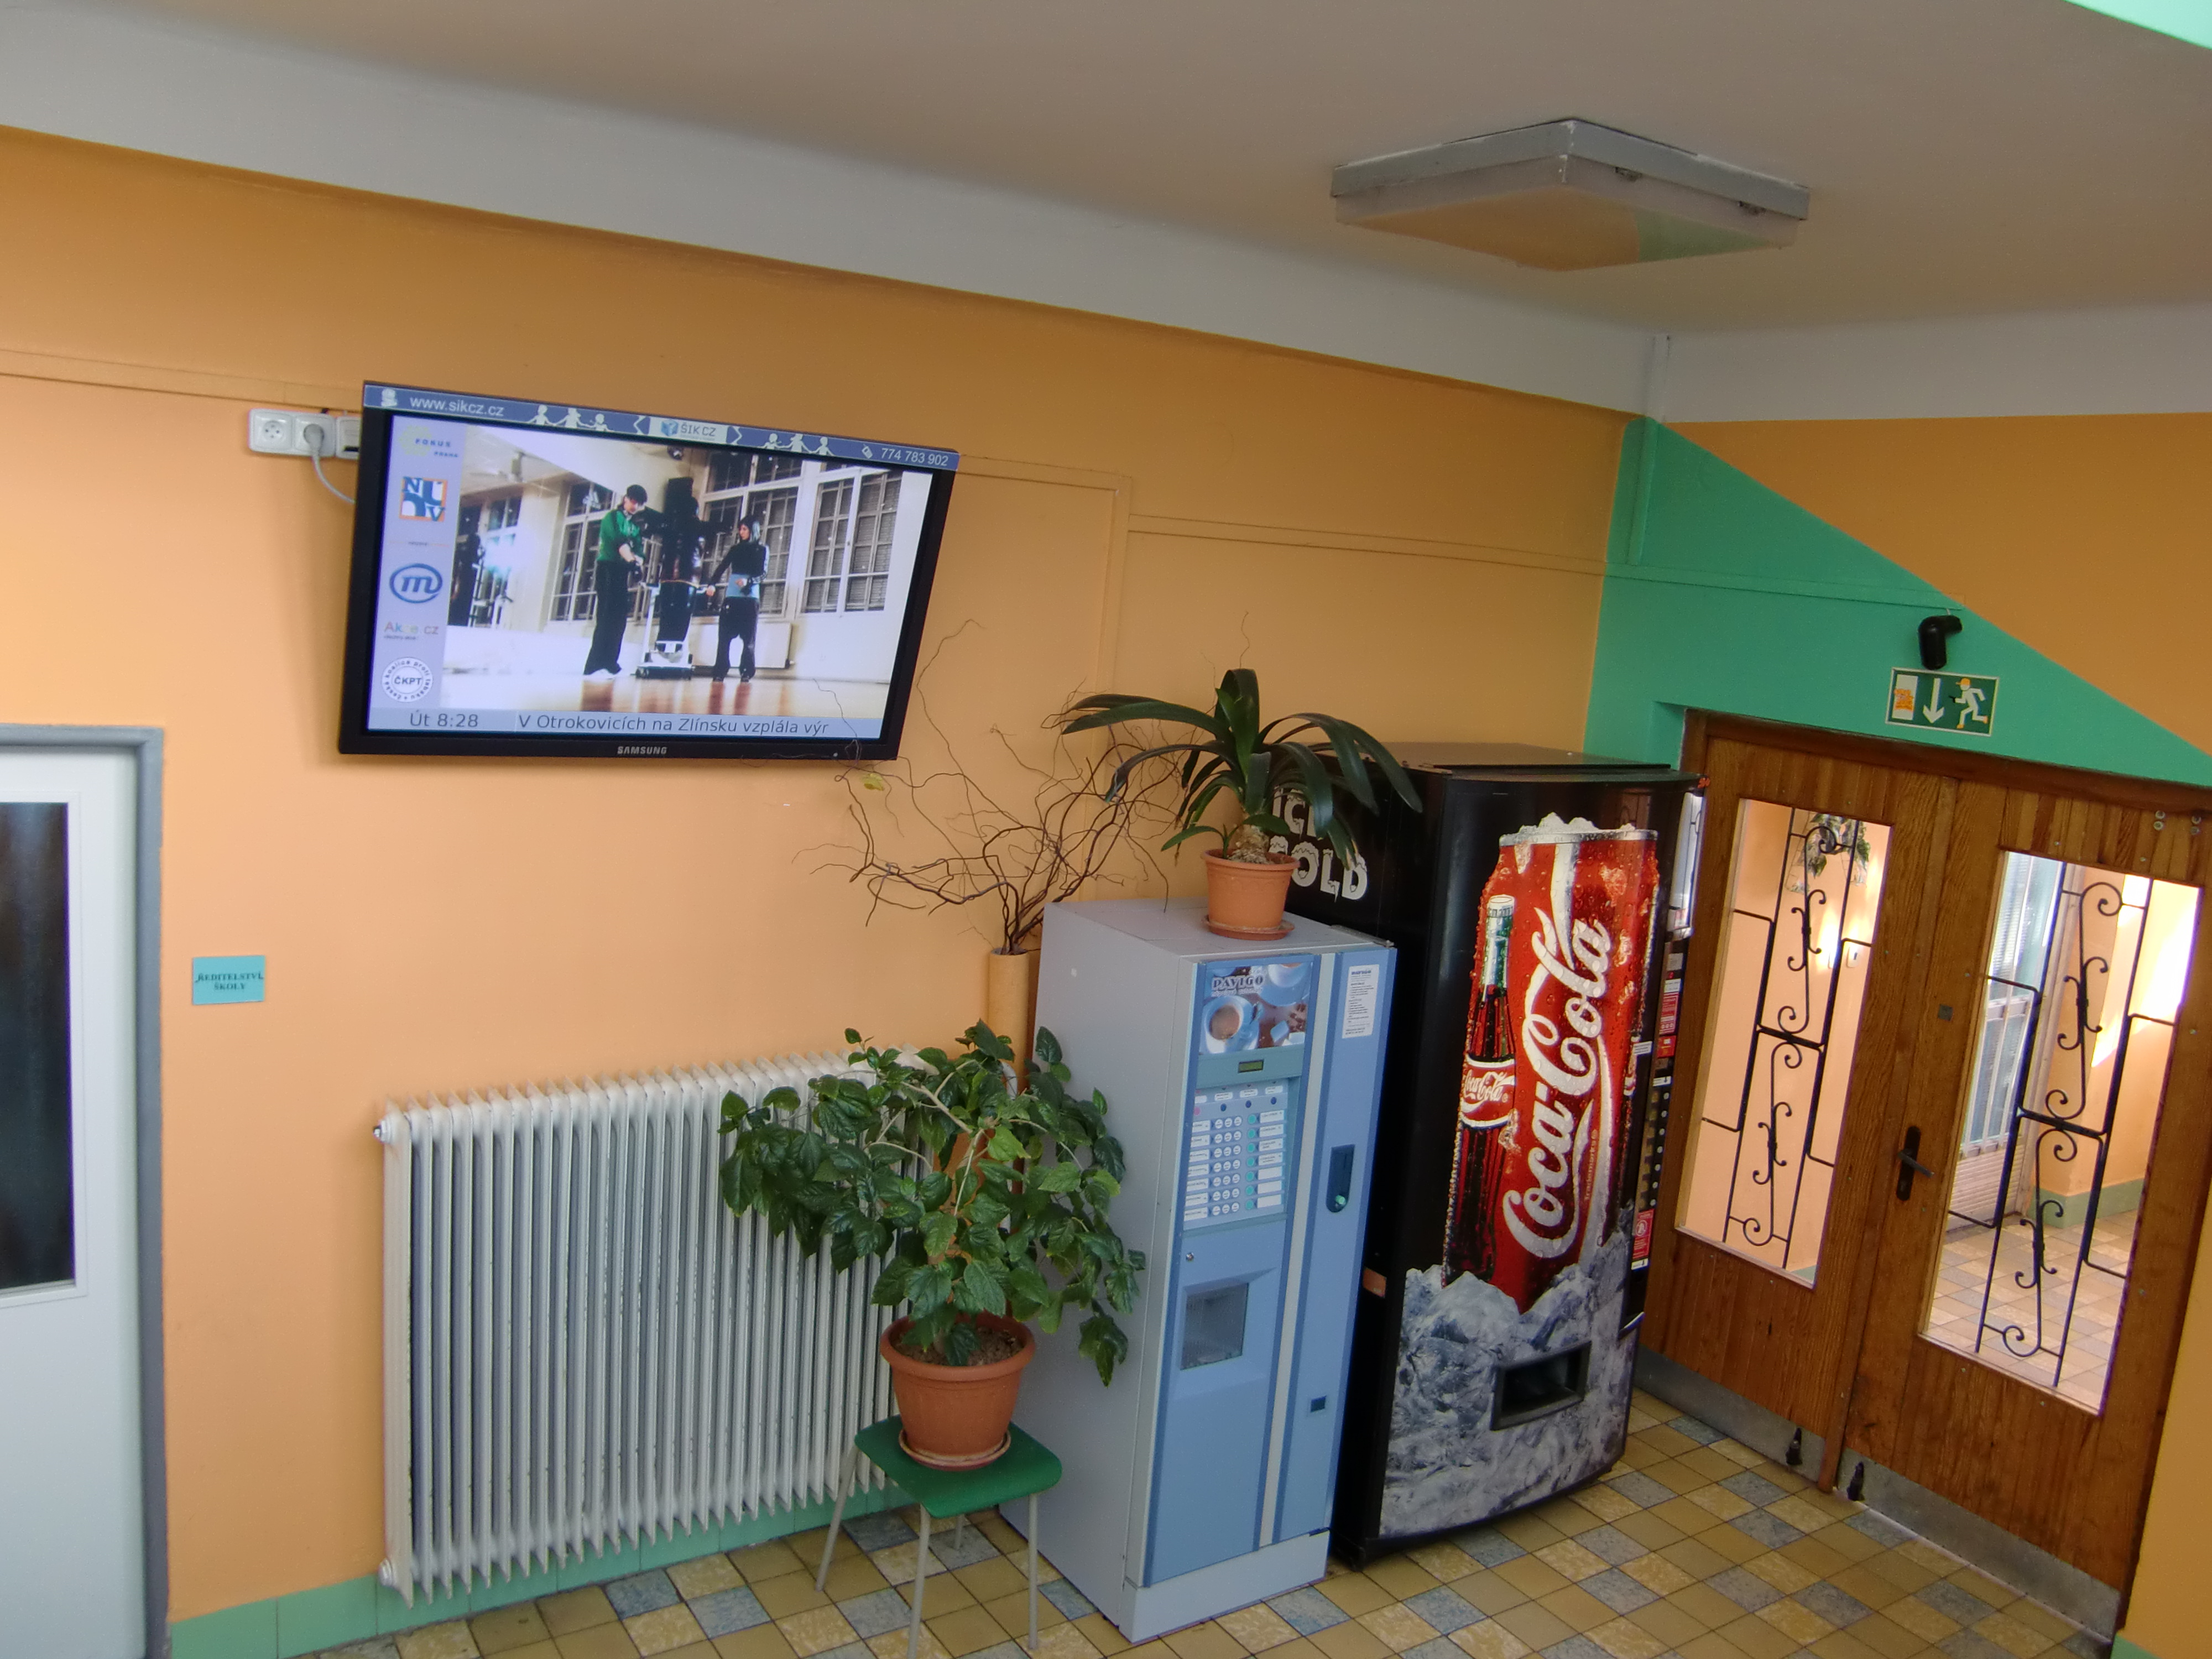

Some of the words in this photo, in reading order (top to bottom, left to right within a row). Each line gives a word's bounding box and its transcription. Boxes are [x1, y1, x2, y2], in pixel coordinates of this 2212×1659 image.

[410, 397, 504, 416] www.sikcz.cz
[702, 426, 716, 436] CZ
[881, 448, 901, 460] 774
[905, 451, 925, 463] 783
[928, 454, 948, 466] 902
[394, 676, 422, 685] ČKPT
[410, 709, 430, 727] Út
[437, 713, 478, 727] 8:28
[519, 714, 531, 728] V
[537, 714, 646, 730] Otrokovicích
[653, 719, 672, 731] na
[678, 717, 737, 732] Zlínsku
[743, 720, 798, 735] vzplála
[804, 721, 829, 736] výr
[617, 746, 667, 754] SAMSUNG
[1213, 976, 1264, 988] PAVIGO
[1503, 907, 1611, 1259] Coca-Cola
